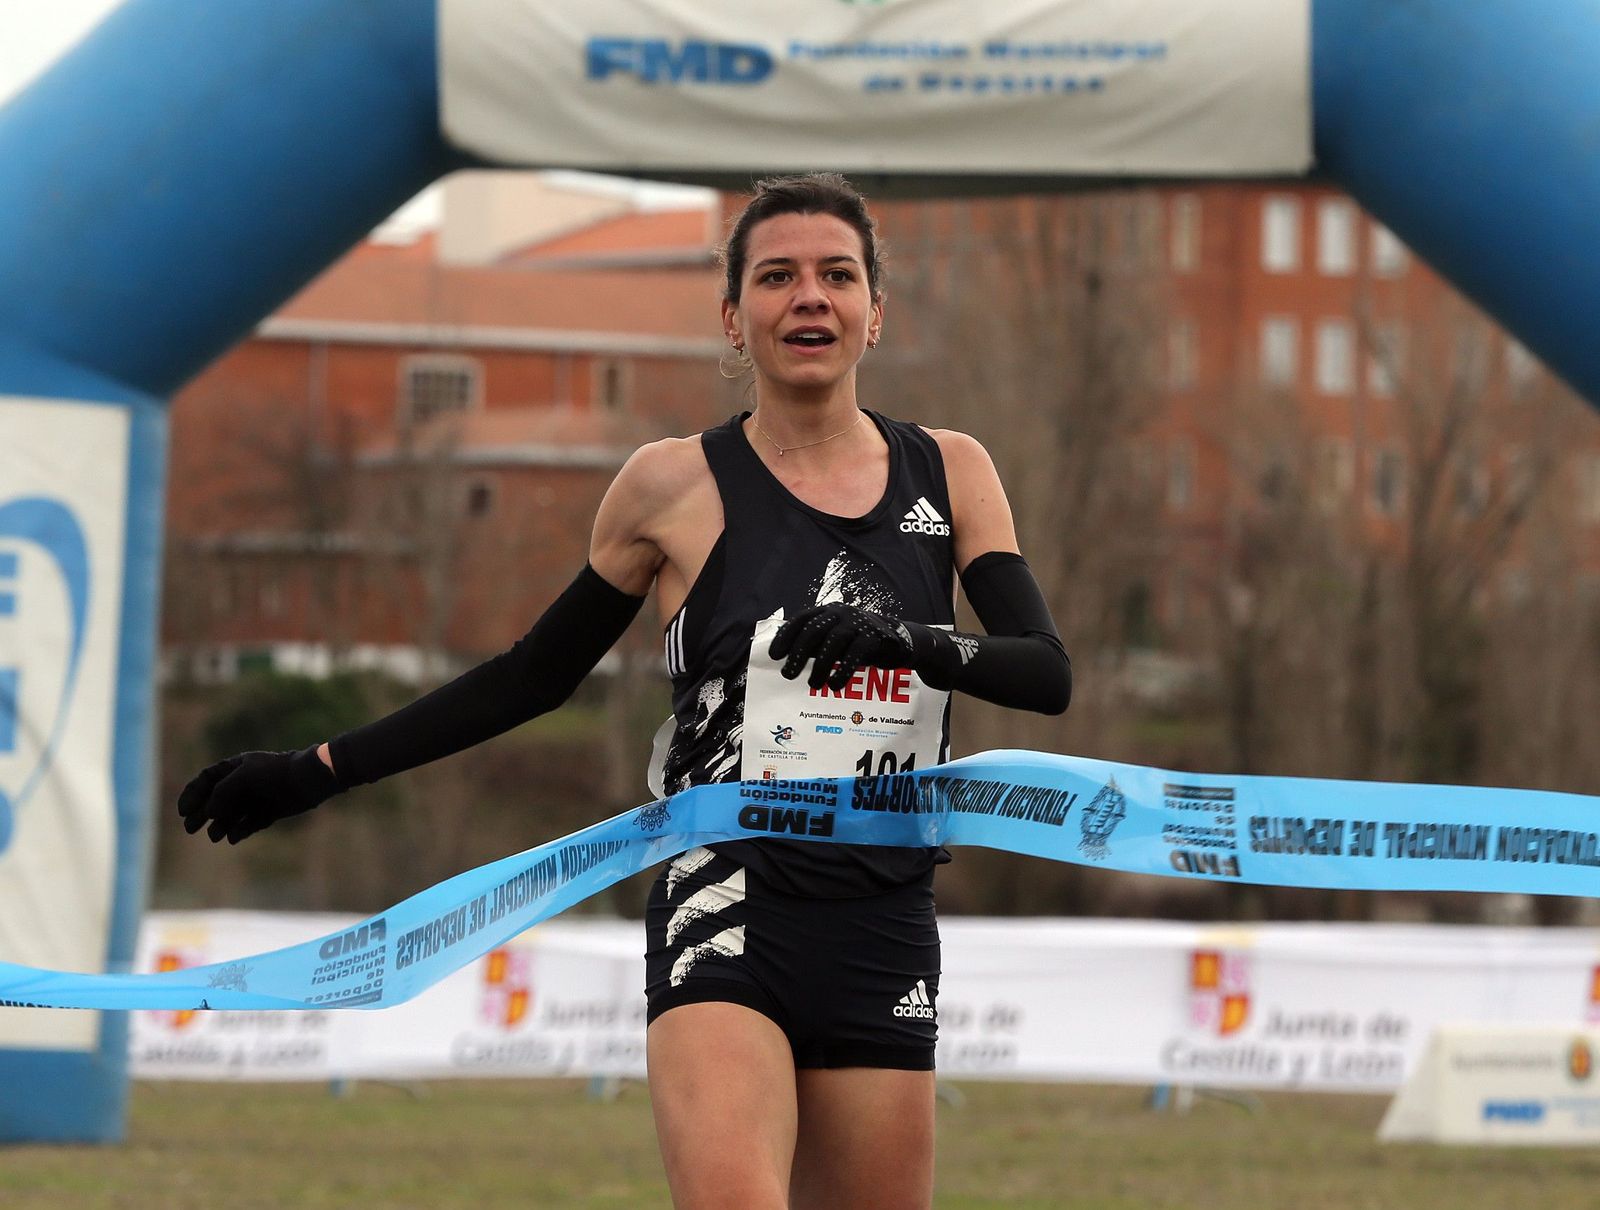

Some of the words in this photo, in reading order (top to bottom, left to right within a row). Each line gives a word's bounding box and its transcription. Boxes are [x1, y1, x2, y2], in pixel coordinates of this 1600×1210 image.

[586, 37, 775, 84] FMD
[900, 519, 950, 536] addas
[809, 665, 912, 703] ENE
[799, 711, 847, 721] Ayuntamiento
[816, 725, 843, 734] FMD
[740, 788, 837, 806] Fundación
[997, 784, 1078, 826] FUNDACION
[738, 804, 836, 837] FMD
[1170, 849, 1242, 877] FMD
[893, 1004, 934, 1019] adidas
